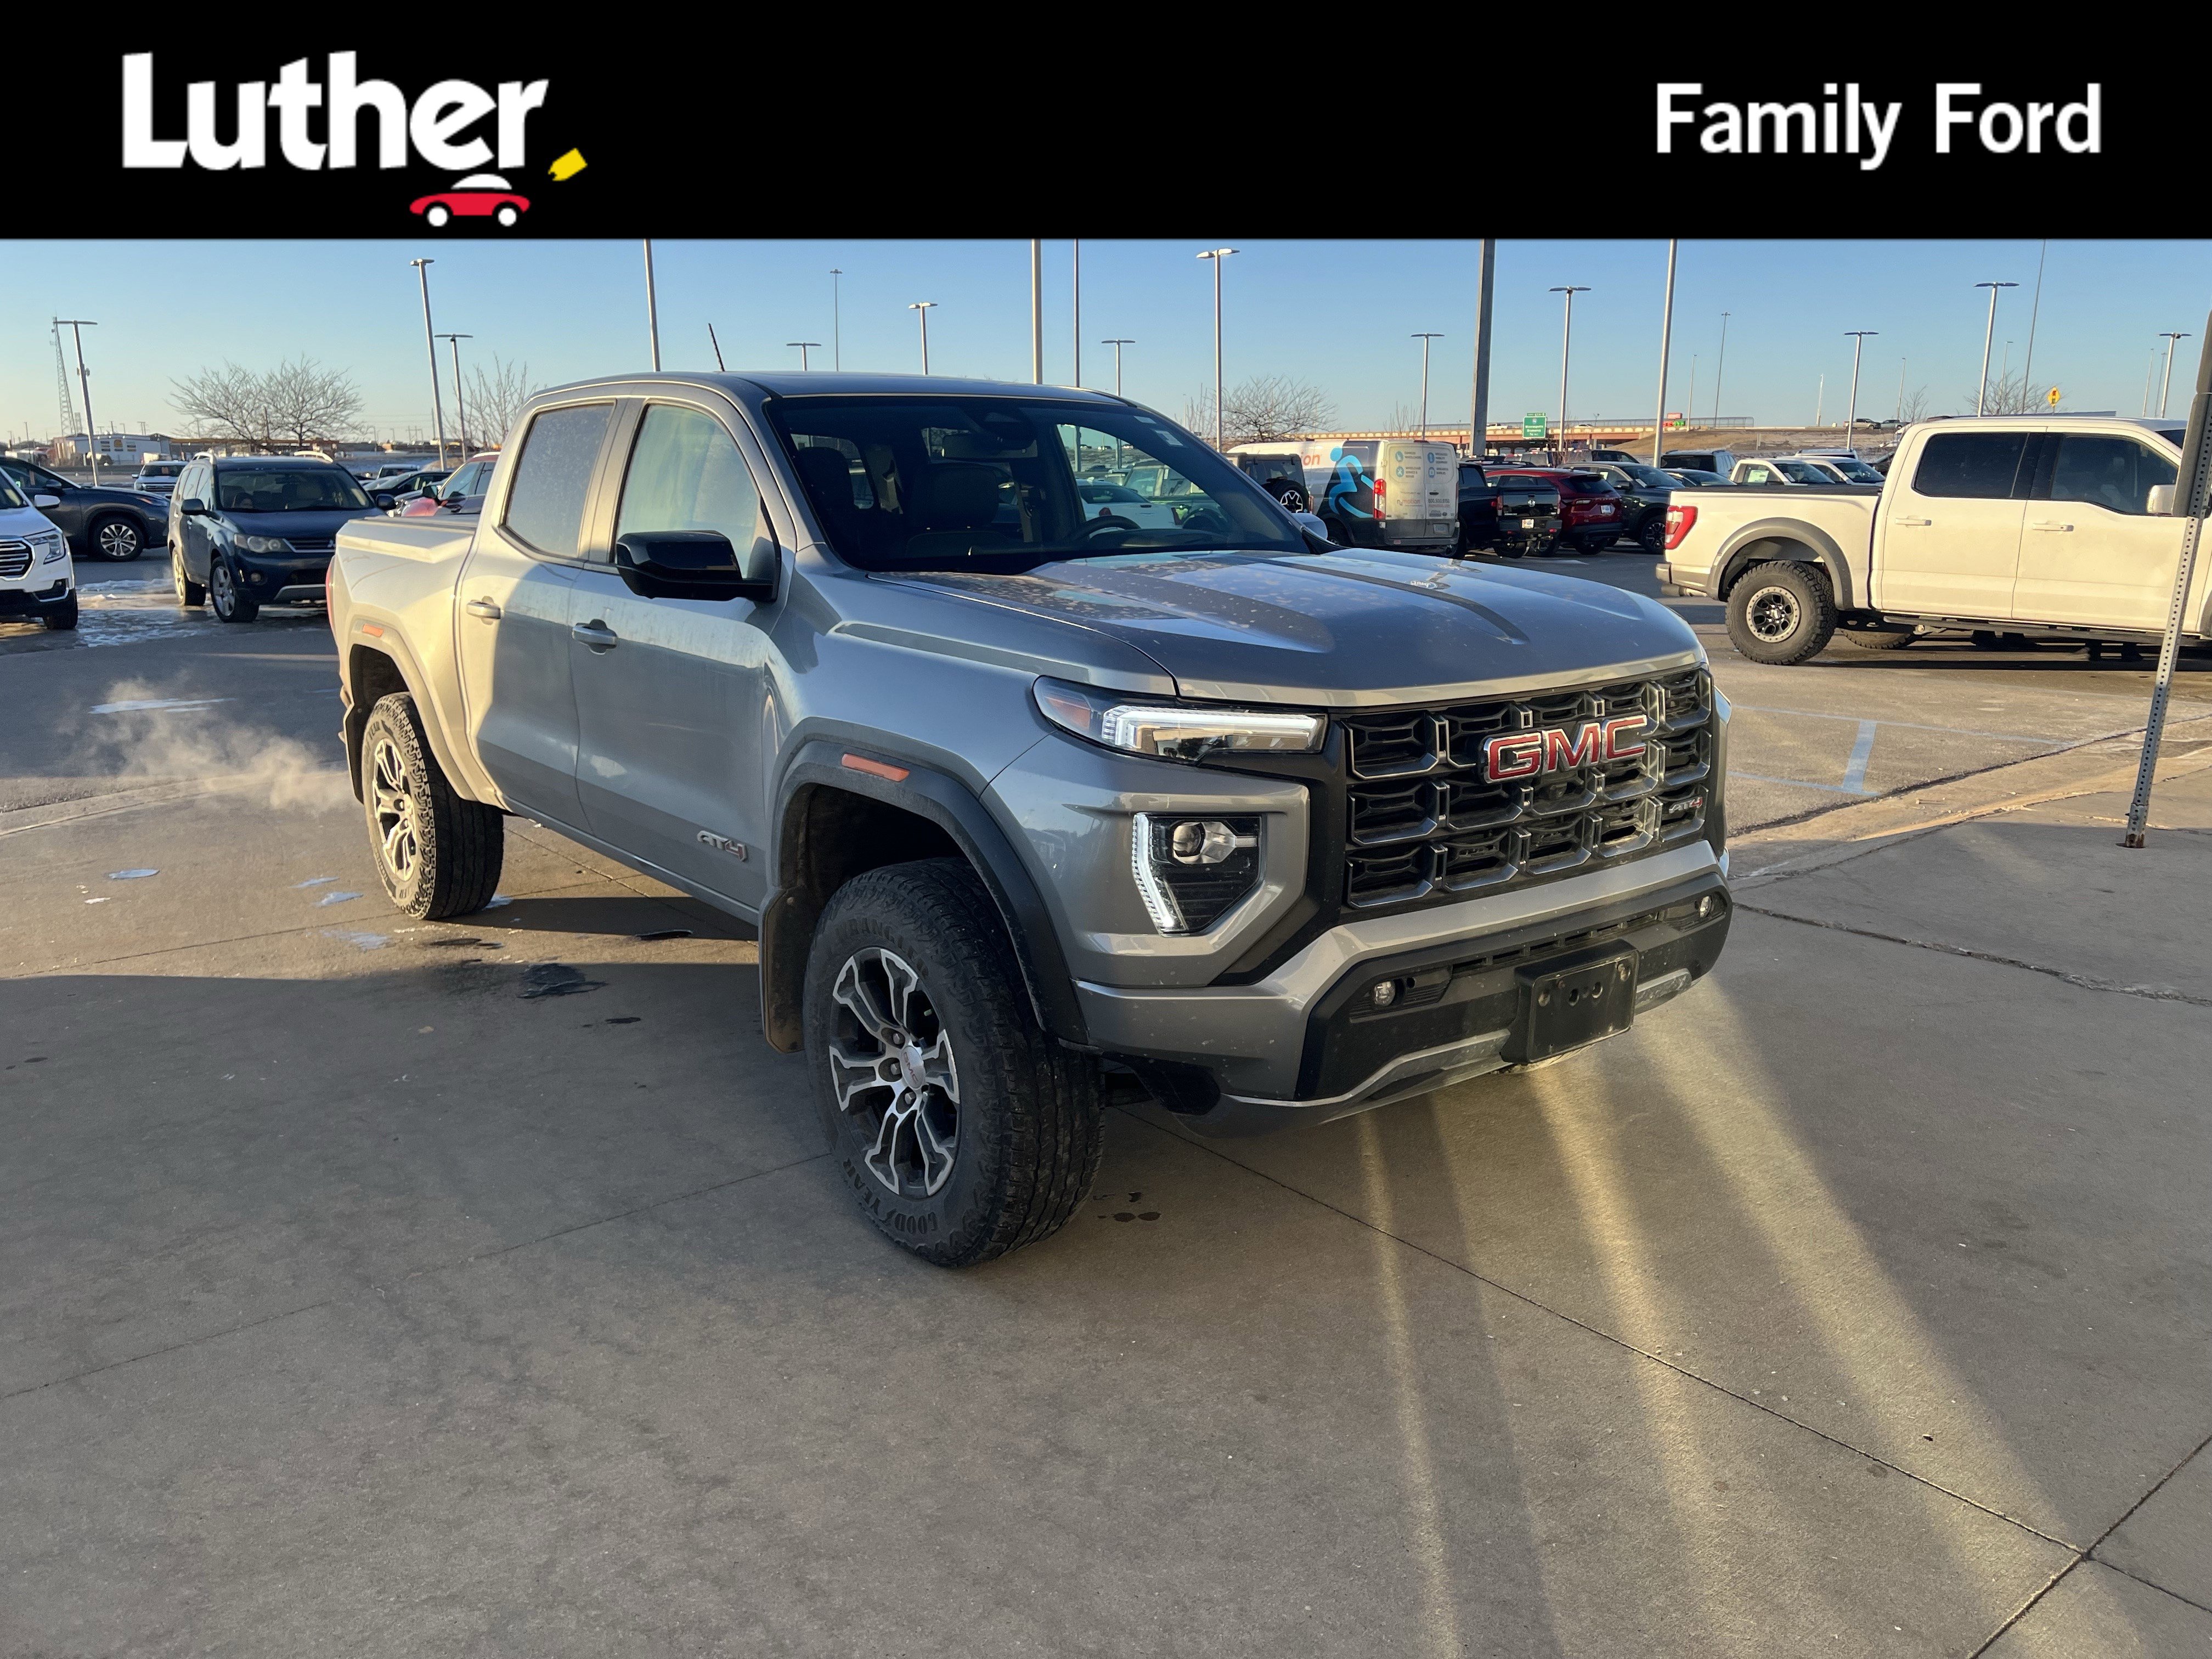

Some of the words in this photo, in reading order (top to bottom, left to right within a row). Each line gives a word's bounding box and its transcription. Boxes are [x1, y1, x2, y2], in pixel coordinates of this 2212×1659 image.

[1483, 714, 1647, 783] GMC
[1668, 797, 1703, 814] AT4
[697, 830, 747, 861] AT4
[903, 1051, 920, 1085] GMC
